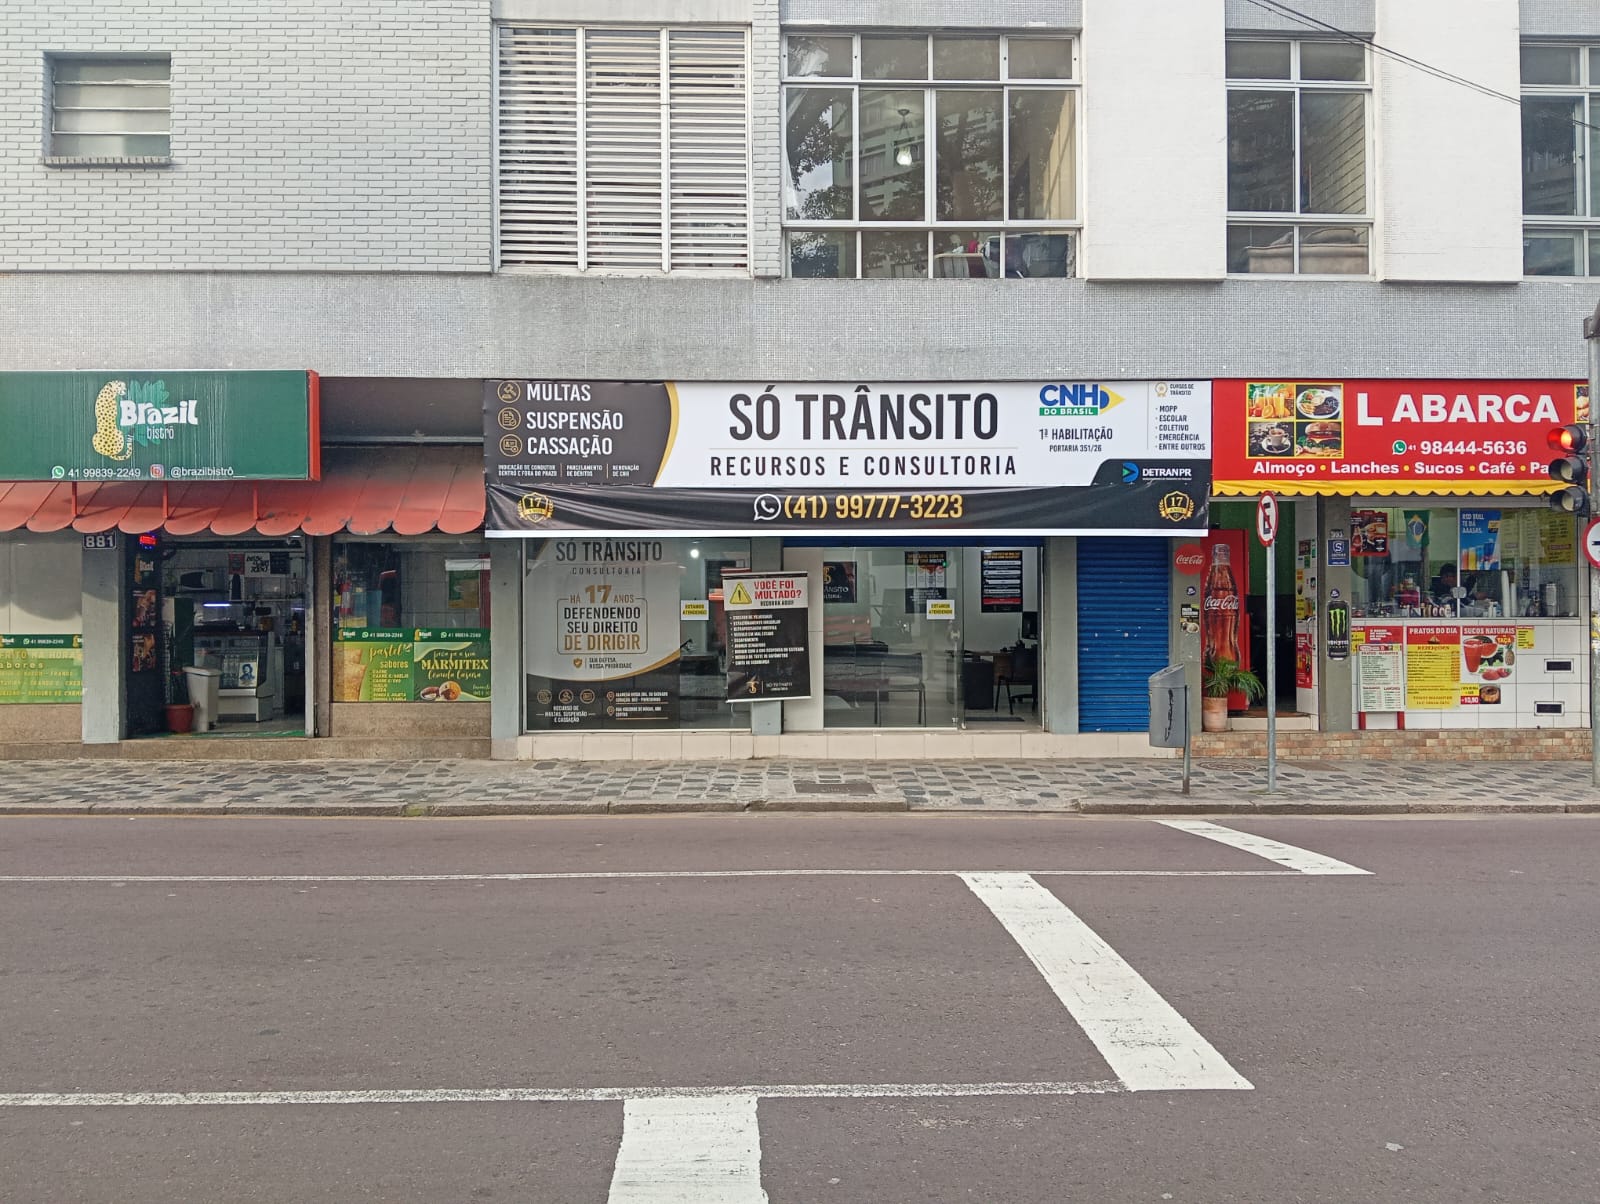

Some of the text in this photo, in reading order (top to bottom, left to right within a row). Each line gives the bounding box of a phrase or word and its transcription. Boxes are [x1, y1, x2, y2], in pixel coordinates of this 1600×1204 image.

[526, 383, 591, 402] MULTAS
[1040, 384, 1098, 406] CNH
[120, 400, 198, 426] Brazil
[729, 385, 998, 440] SÓ TRÂNSITO
[1357, 392, 1560, 426] L ABARCA
[526, 410, 624, 430] SUSPENSÃO
[1159, 414, 1187, 422] ESCOLAR
[1052, 426, 1113, 442] HABILITAÇÃO
[527, 434, 613, 458] CASSAÇÃO
[1050, 444, 1078, 452] PORTARIA
[1420, 440, 1528, 455] 98444-5636
[68, 468, 79, 478] 41
[83, 468, 141, 478] 99839-2249
[710, 456, 1016, 476] RECURSOS E CONSULTORIA
[1253, 462, 1550, 476] Almoço Lanches Sucos Café Pa
[530, 498, 542, 507] 17
[784, 494, 963, 519] (41) 99777-3223
[1170, 496, 1183, 506] 17
[85, 536, 114, 548] 881
[556, 538, 662, 562] SÓ TRÂNSITO
[754, 580, 794, 590] VOCÊ FOI
[570, 584, 634, 604] HÁ 17 ANOS
[755, 590, 802, 600] MULTADO?
[564, 607, 640, 619] DEFENDENDO
[567, 621, 638, 634] SEU DIREITO
[564, 634, 640, 650] DE DIRIGIR
[422, 660, 488, 670] MARMITEX
